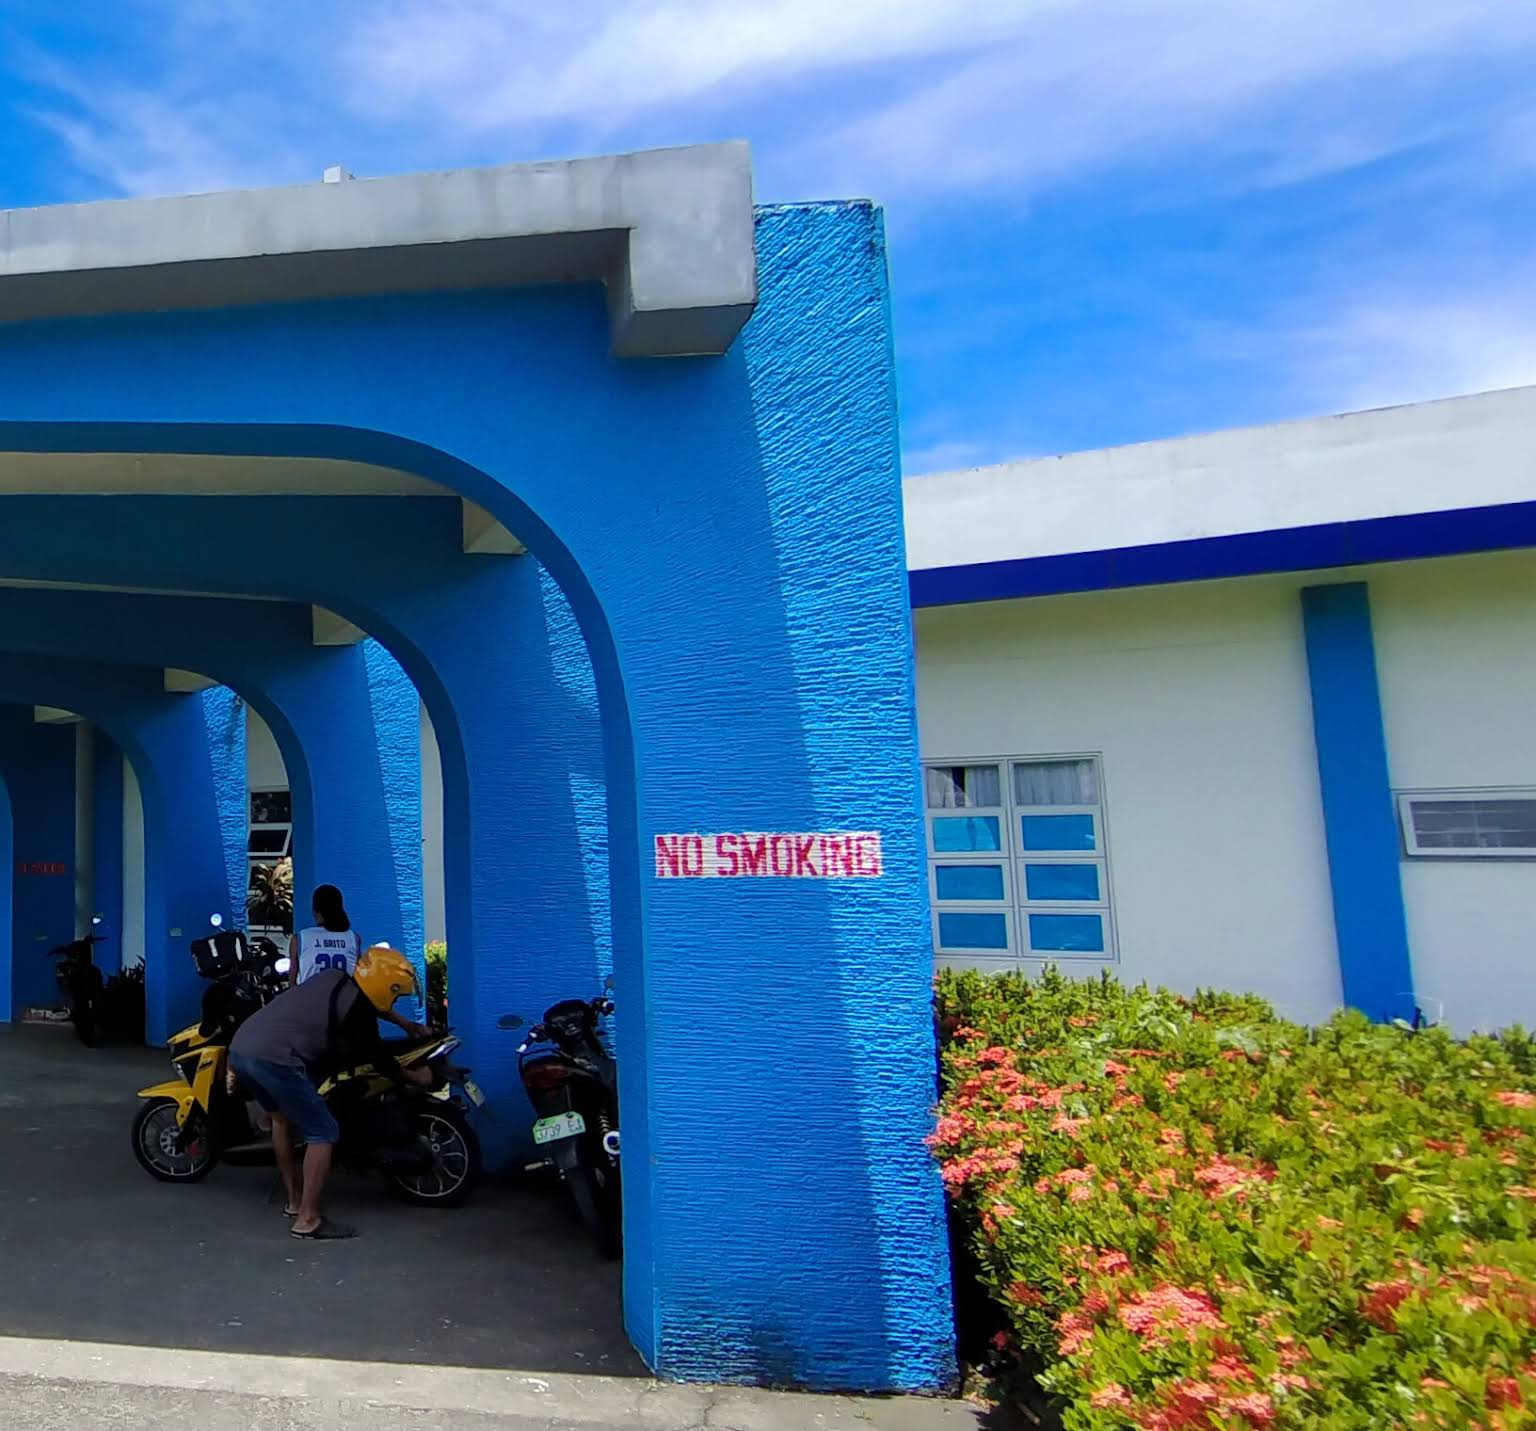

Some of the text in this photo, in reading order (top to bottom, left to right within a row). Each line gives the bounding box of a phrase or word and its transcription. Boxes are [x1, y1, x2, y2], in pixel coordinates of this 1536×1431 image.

[656, 834, 881, 876] NO SMOKING
[323, 939, 346, 948] BRITO
